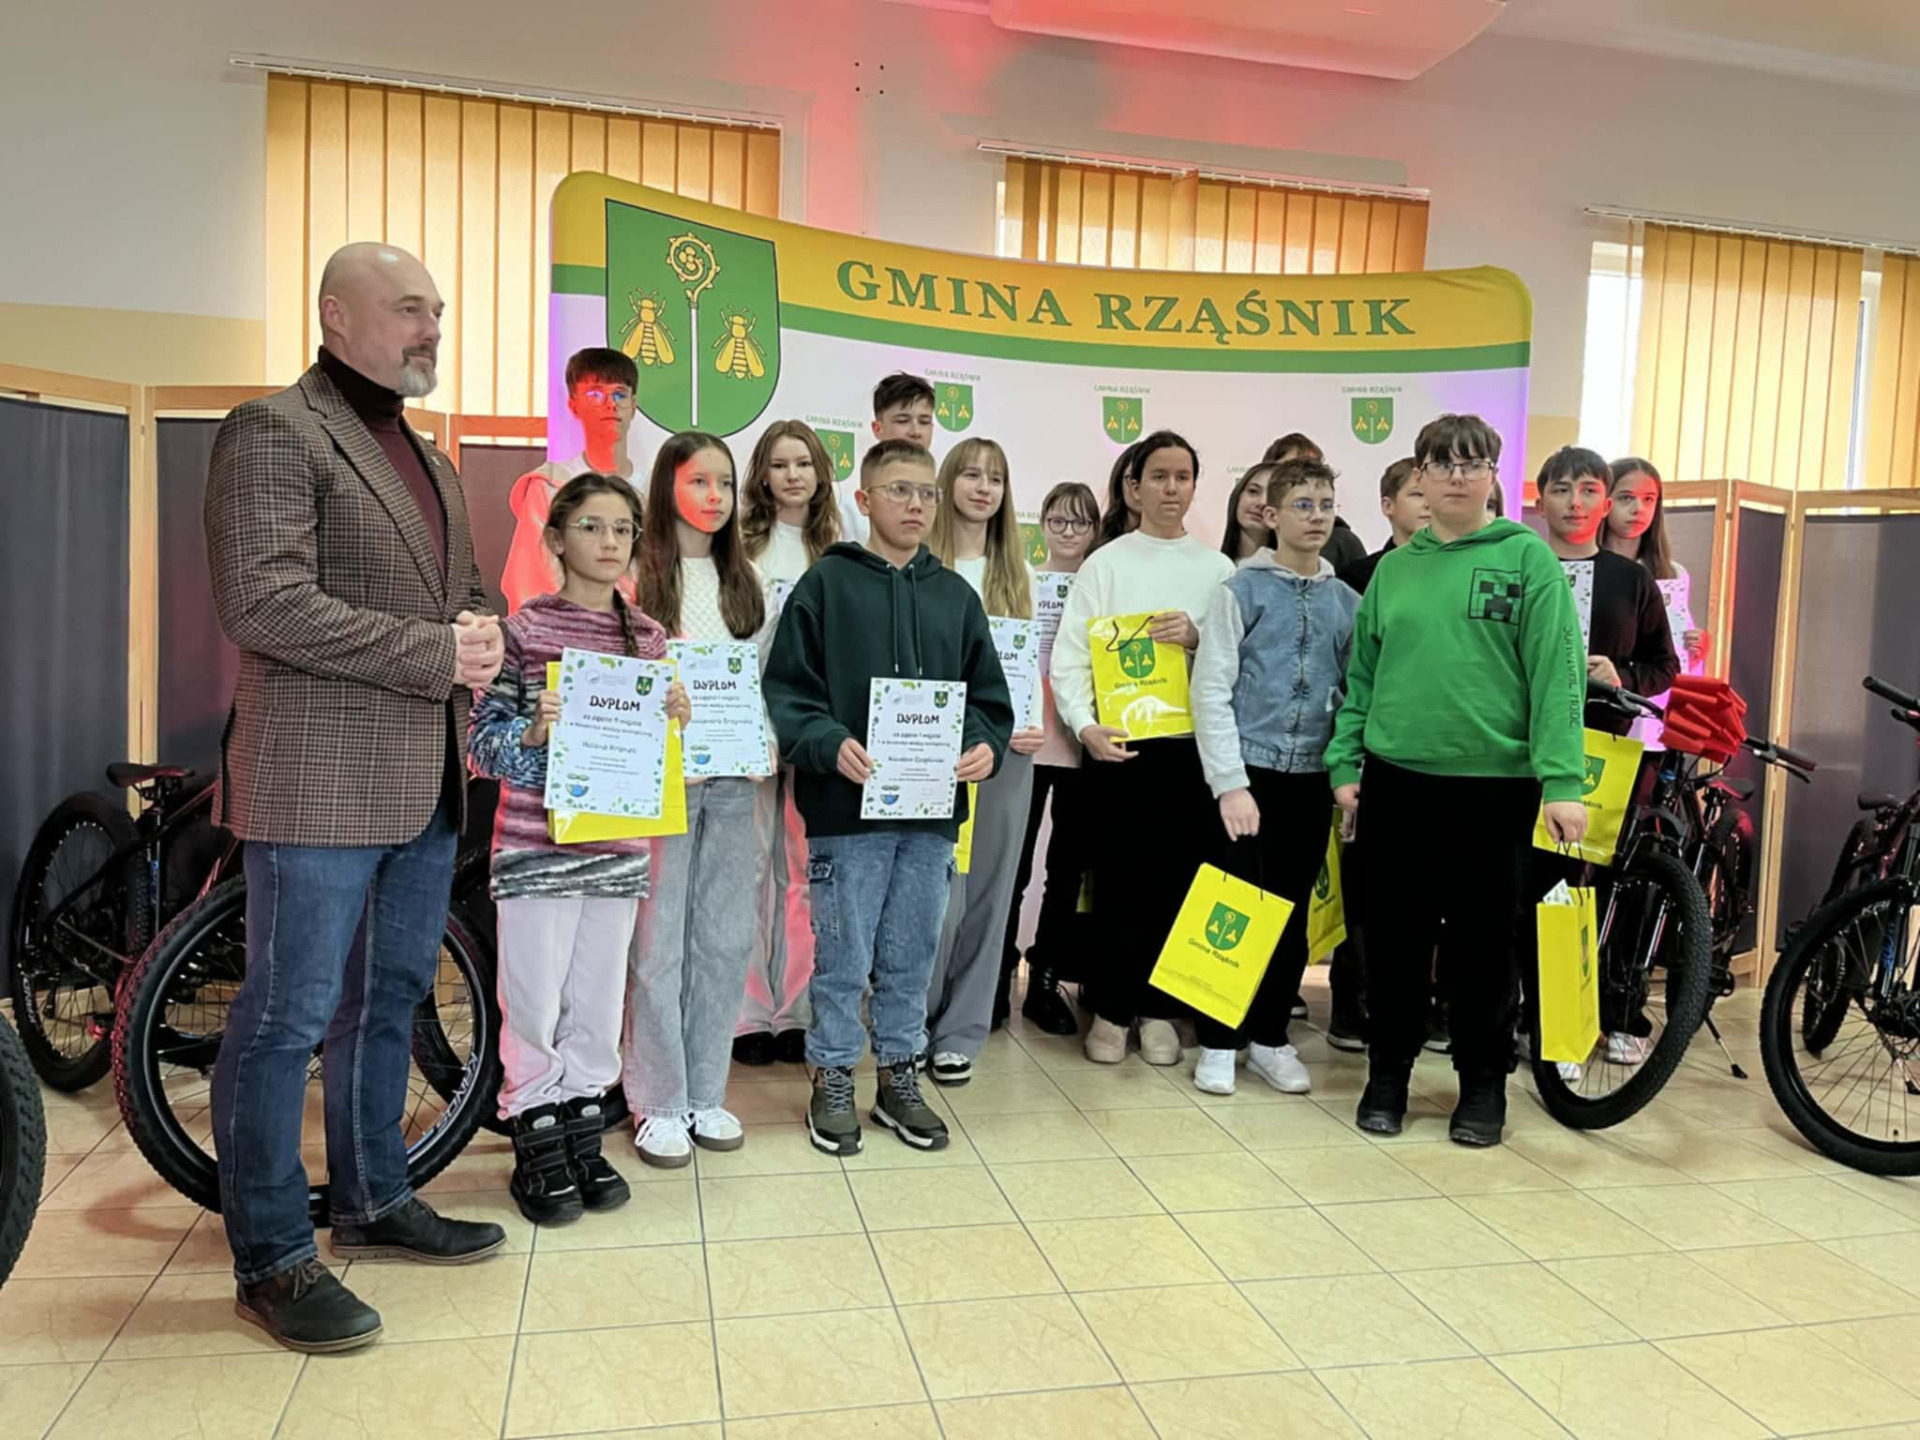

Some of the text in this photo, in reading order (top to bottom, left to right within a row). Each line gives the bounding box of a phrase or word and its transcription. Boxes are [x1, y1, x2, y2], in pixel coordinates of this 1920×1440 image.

[836, 260, 1416, 345] GMINA RZĄŚNIK
[693, 680, 737, 690] DYPLOM
[589, 695, 641, 711] DYPLOM
[896, 713, 940, 725] DYPLOM
